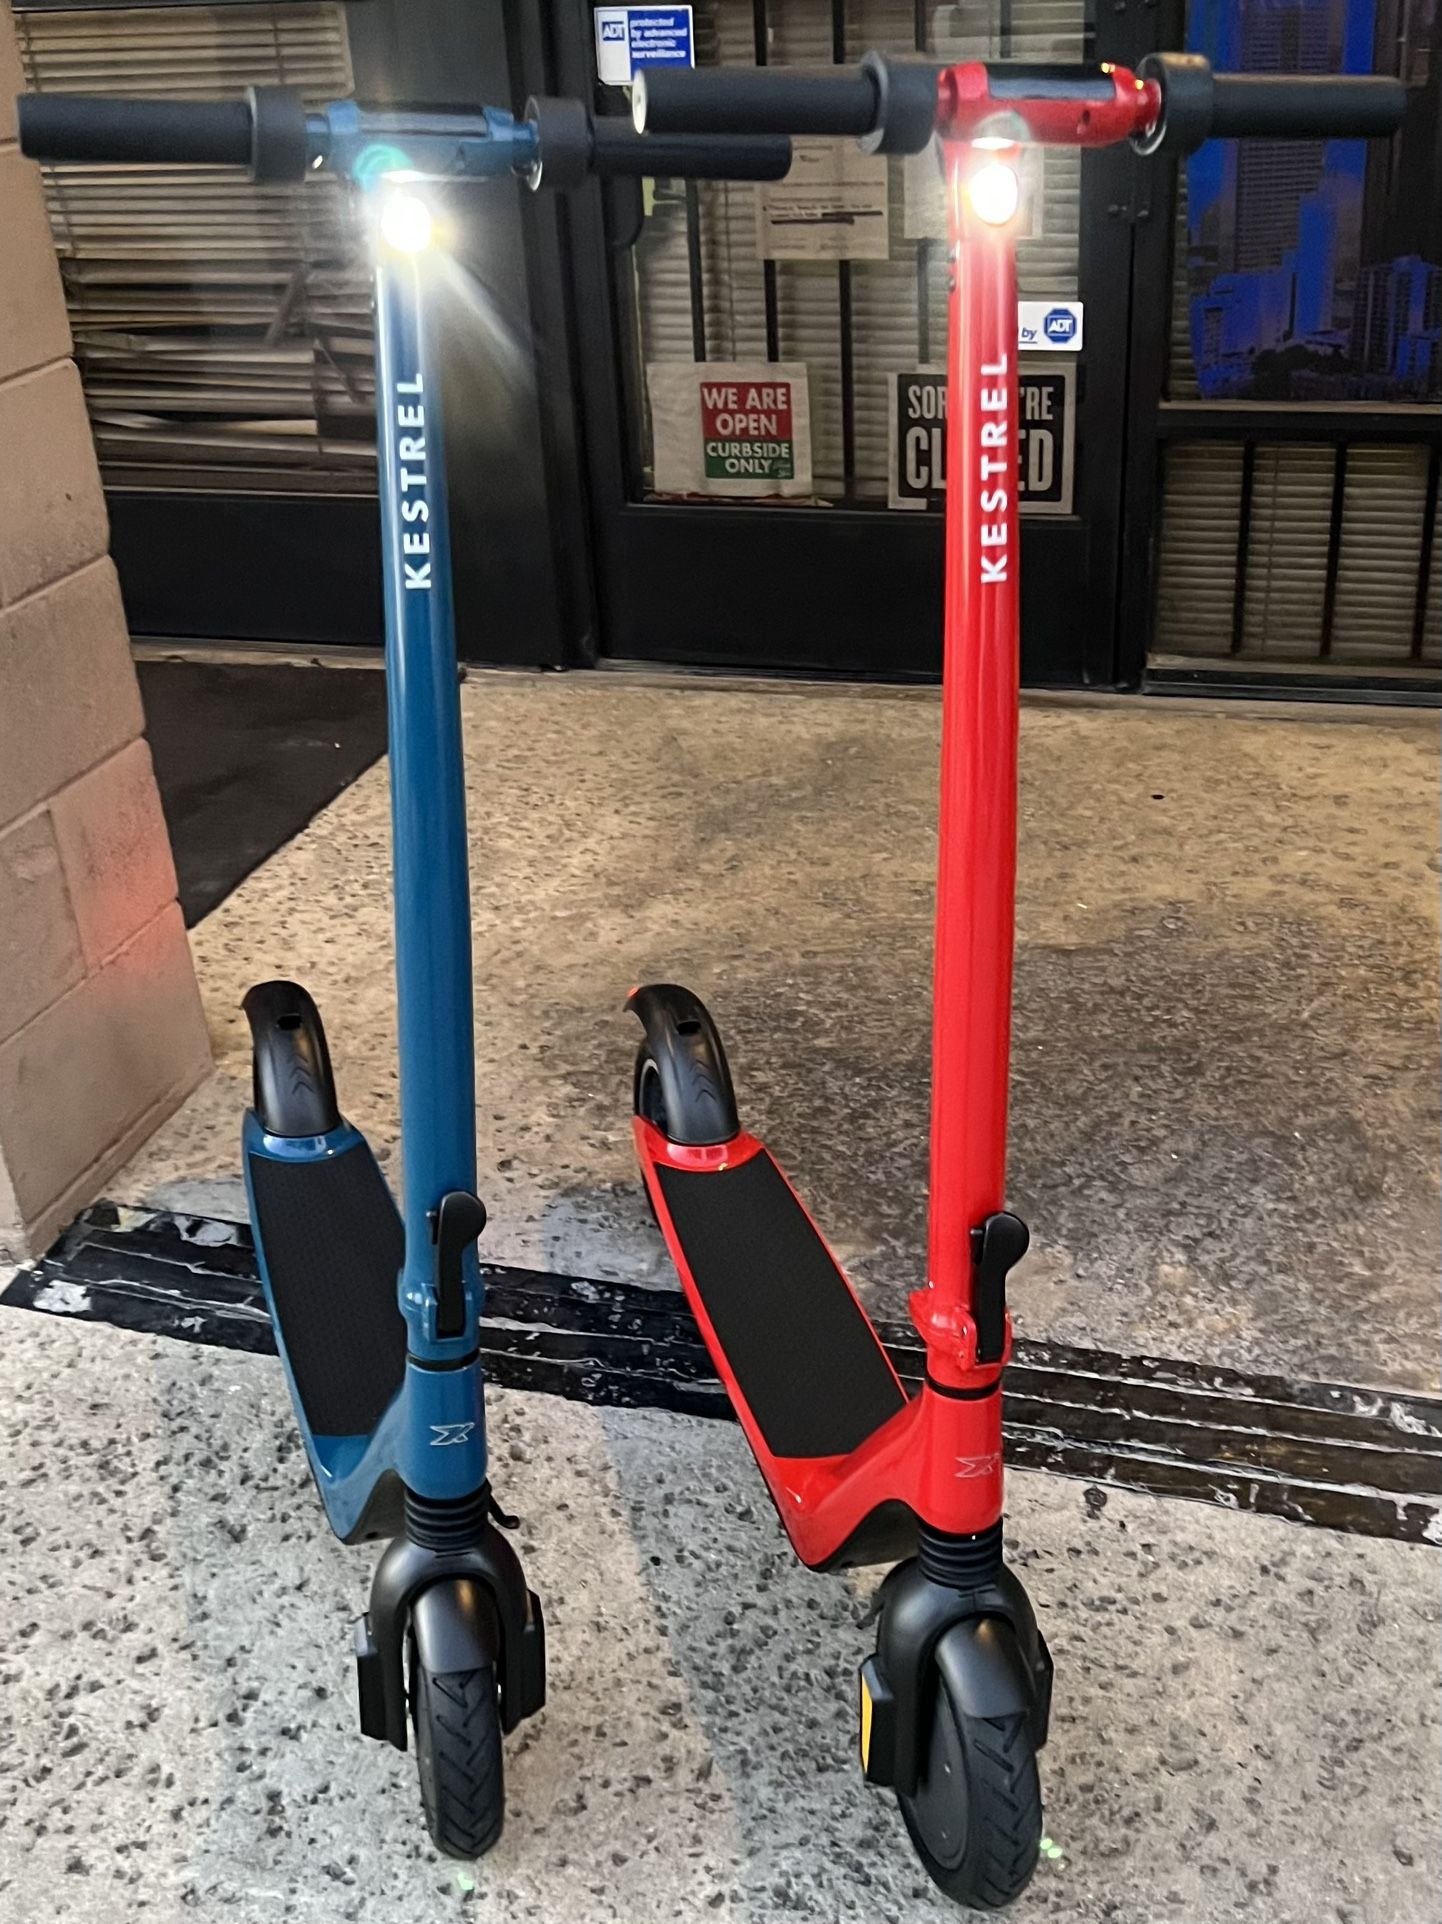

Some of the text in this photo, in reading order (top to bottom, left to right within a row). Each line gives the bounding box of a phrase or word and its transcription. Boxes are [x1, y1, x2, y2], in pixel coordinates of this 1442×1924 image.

[603, 23, 624, 39] ADT
[630, 29, 642, 41] by
[1021, 319, 1073, 340] by ADT
[702, 387, 788, 410] WE ARE
[715, 413, 777, 436] OPEN
[706, 442, 790, 458] CURBSIDE
[725, 459, 772, 473] ONLY
[980, 352, 1008, 583] KESTREL
[396, 373, 431, 589] KESTREL
